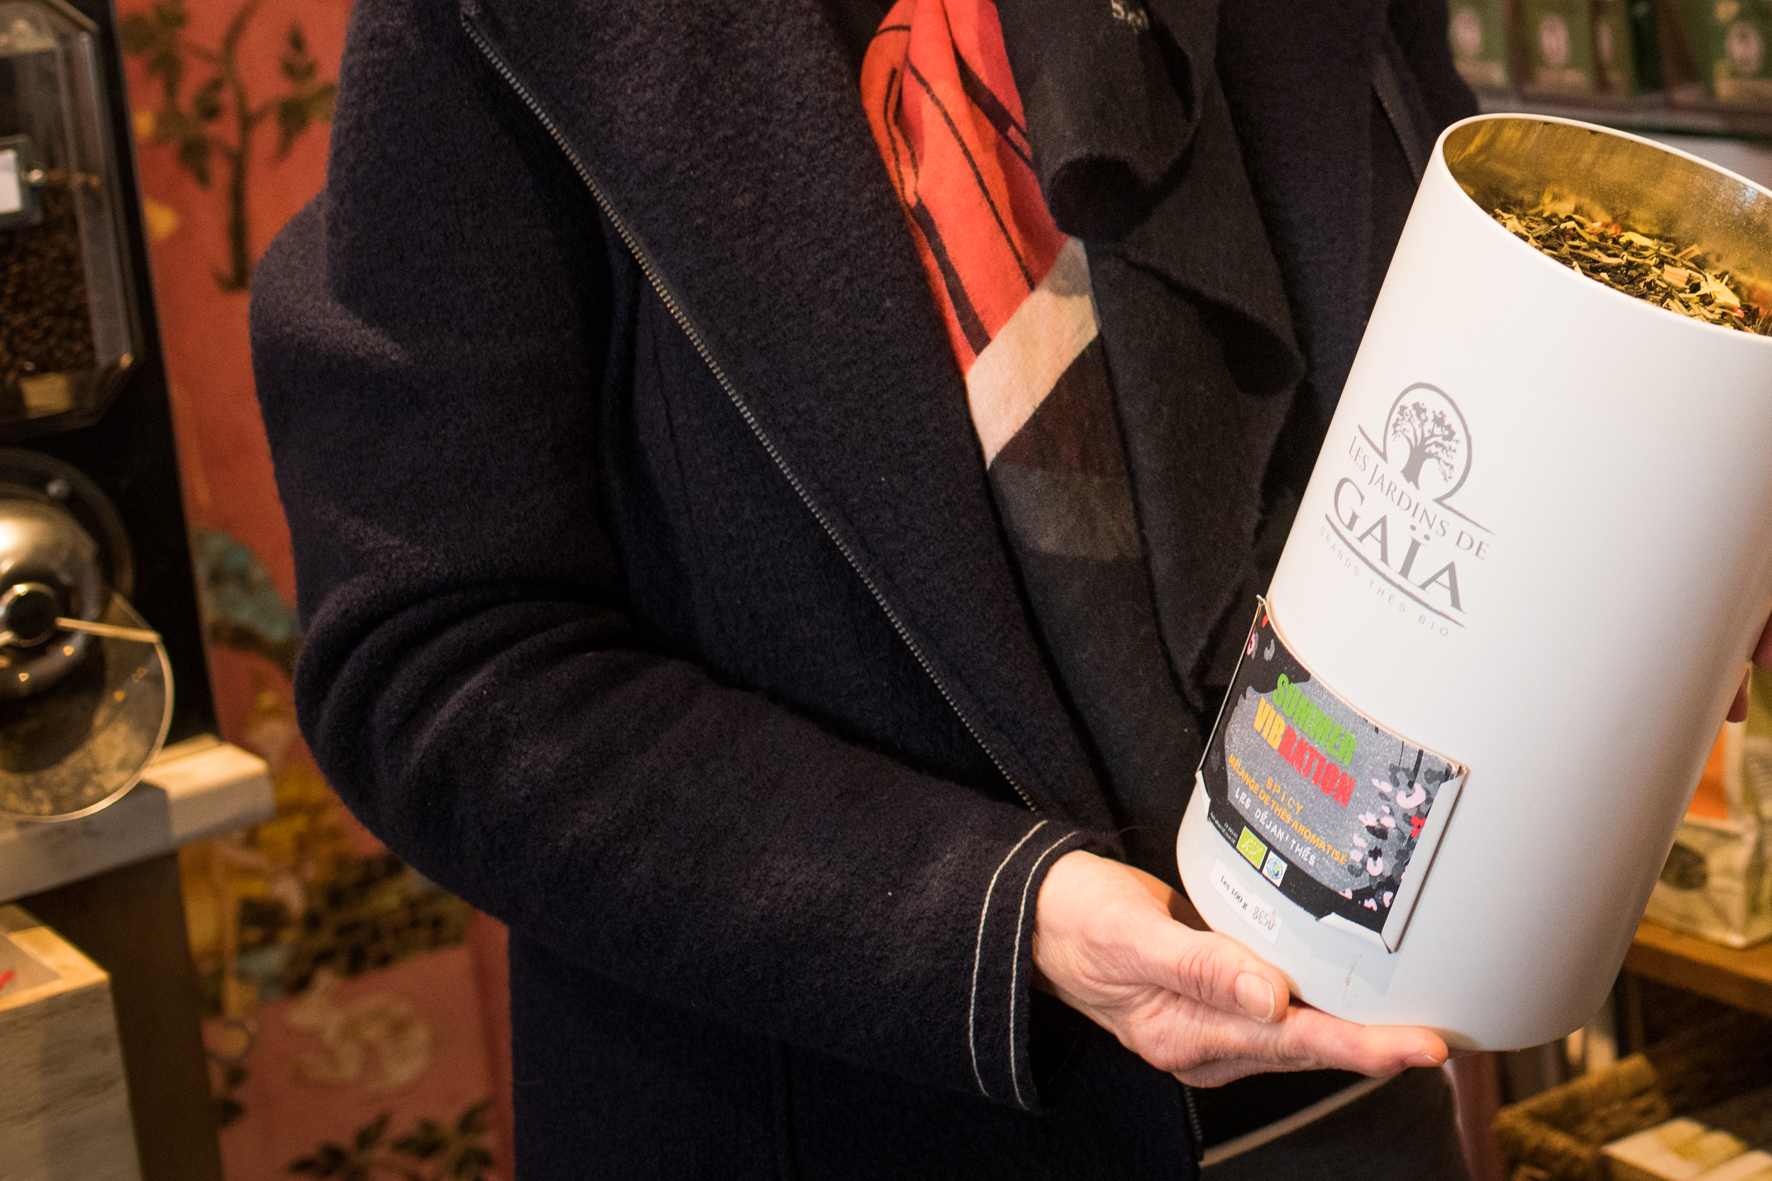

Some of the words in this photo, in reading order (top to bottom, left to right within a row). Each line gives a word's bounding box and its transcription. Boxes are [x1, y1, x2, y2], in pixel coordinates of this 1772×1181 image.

[1348, 435, 1370, 473] LES
[1367, 463, 1450, 538] JARDINS
[1454, 529, 1490, 560] DE
[1319, 525, 1360, 577] GRANDS
[1367, 578, 1407, 613] THÉS
[1417, 613, 1449, 637] BIO
[1253, 696, 1357, 808] VIBRATION
[1272, 673, 1357, 767] SUMMER
[1228, 753, 1259, 795] MÉLANGE
[1258, 789, 1270, 806] DE
[1270, 799, 1292, 825] THÉS
[1290, 819, 1348, 866] AROMATISÉ
[1234, 787, 1252, 809] LES
[1290, 838, 1317, 866] THÉS
[1265, 776, 1304, 815] SPICY
[1220, 875, 1231, 890] Les
[1231, 888, 1244, 904] 100
